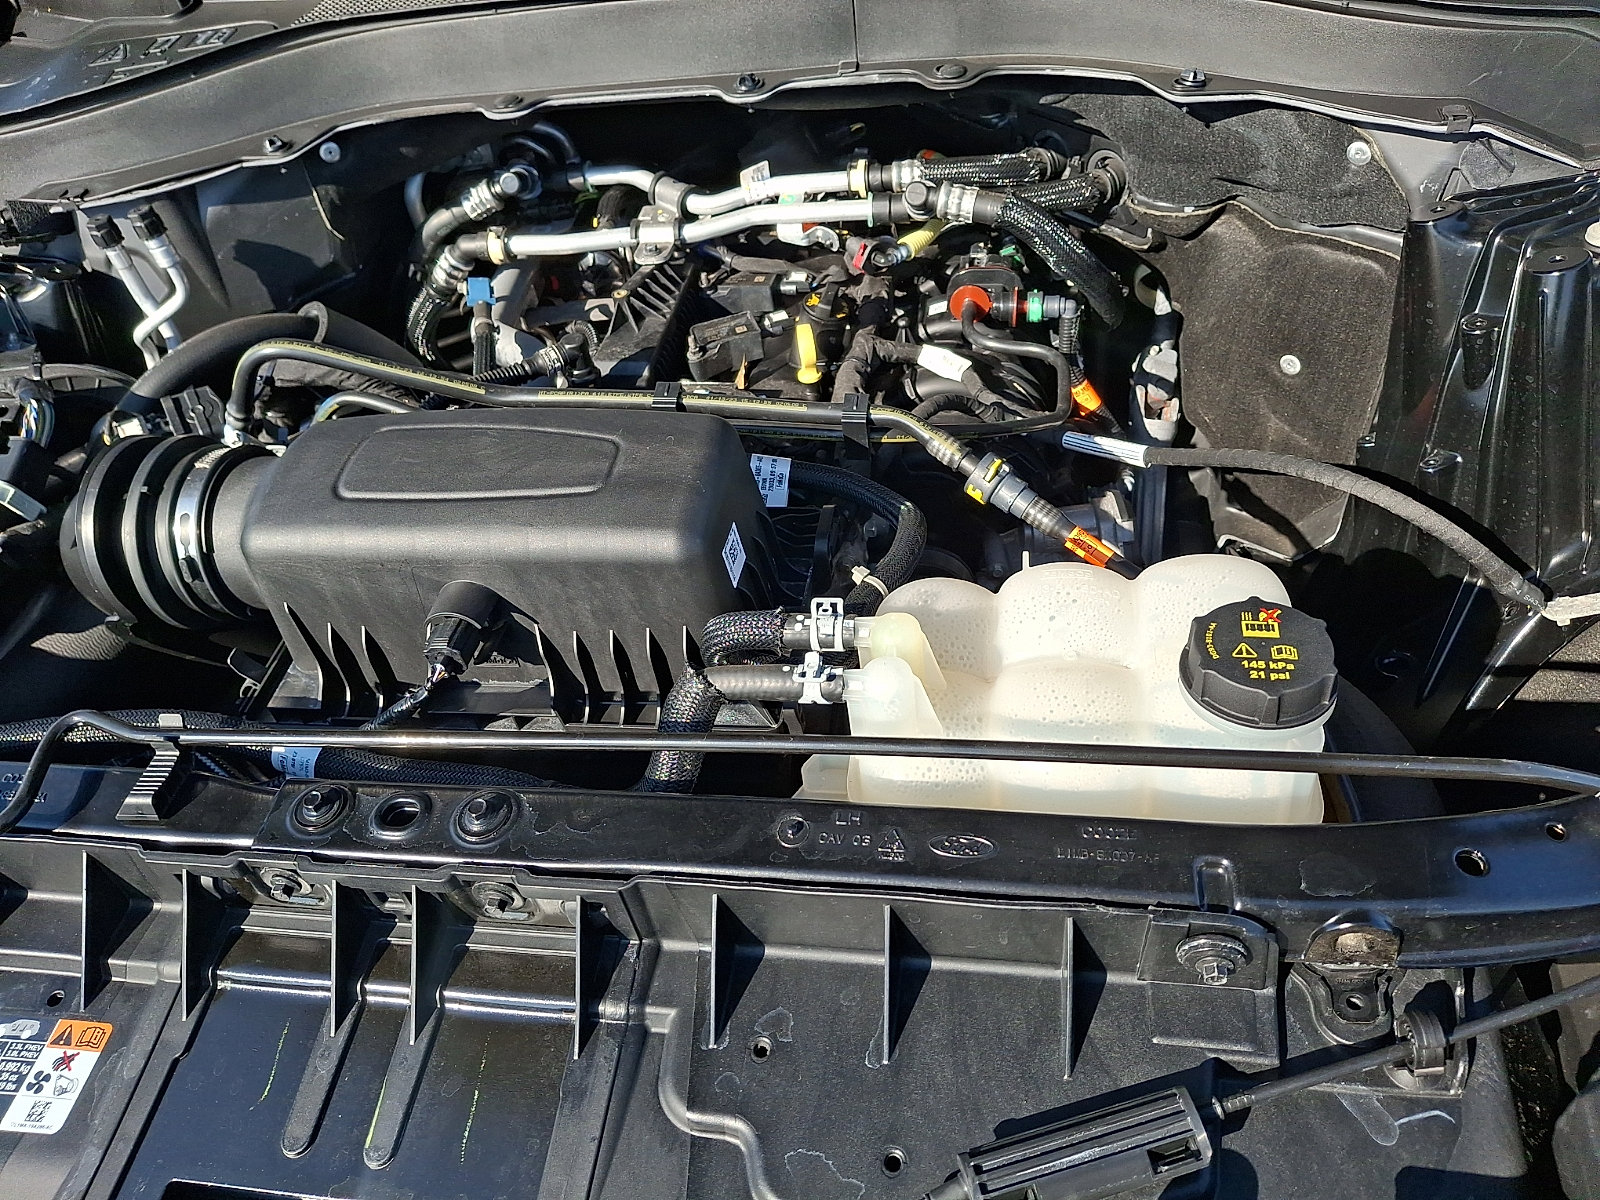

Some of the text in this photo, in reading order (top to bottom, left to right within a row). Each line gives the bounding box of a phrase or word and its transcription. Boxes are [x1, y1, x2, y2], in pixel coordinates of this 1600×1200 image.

[1241, 660, 1295, 670] 145 kPa
[1249, 670, 1291, 681] 21 psi
[835, 812, 861, 826] LH
[818, 832, 844, 845] CAV
[20, 1062, 32, 1075] kg
